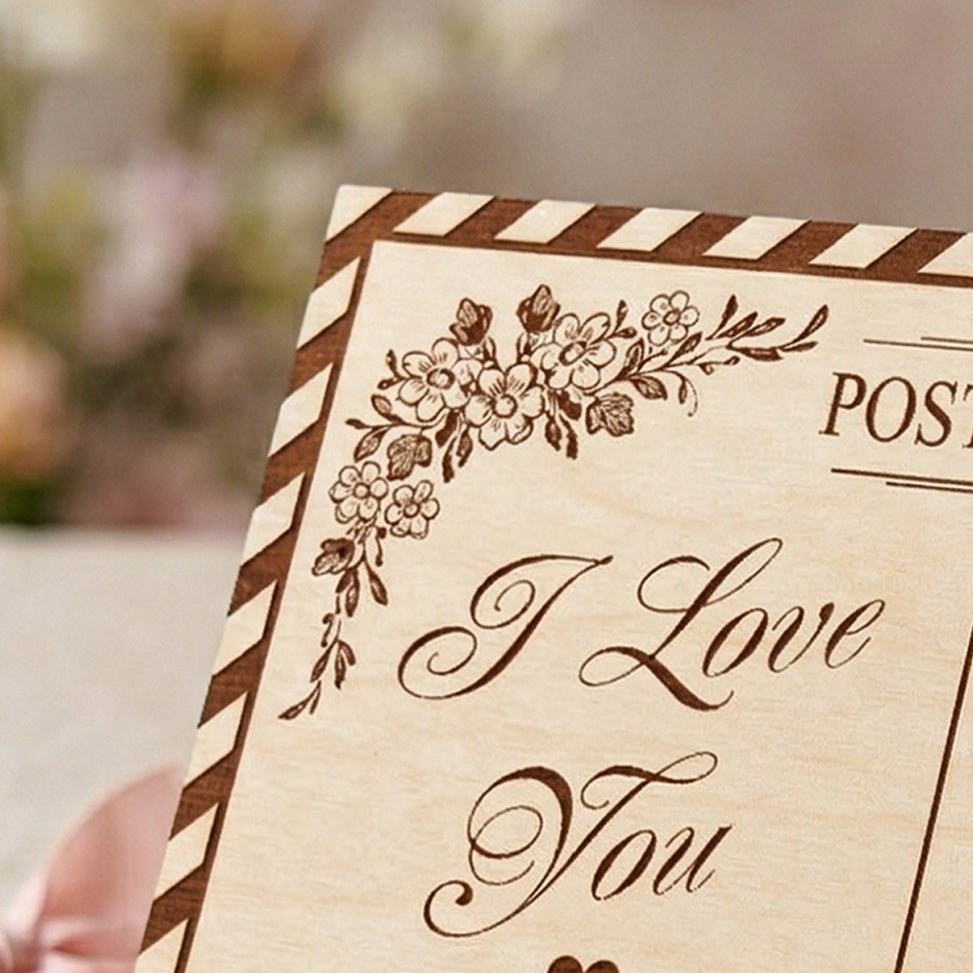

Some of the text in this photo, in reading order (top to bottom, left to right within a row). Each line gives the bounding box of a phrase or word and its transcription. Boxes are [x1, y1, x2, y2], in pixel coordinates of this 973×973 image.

[398, 537, 886, 711] I Love
[423, 751, 733, 938] You
